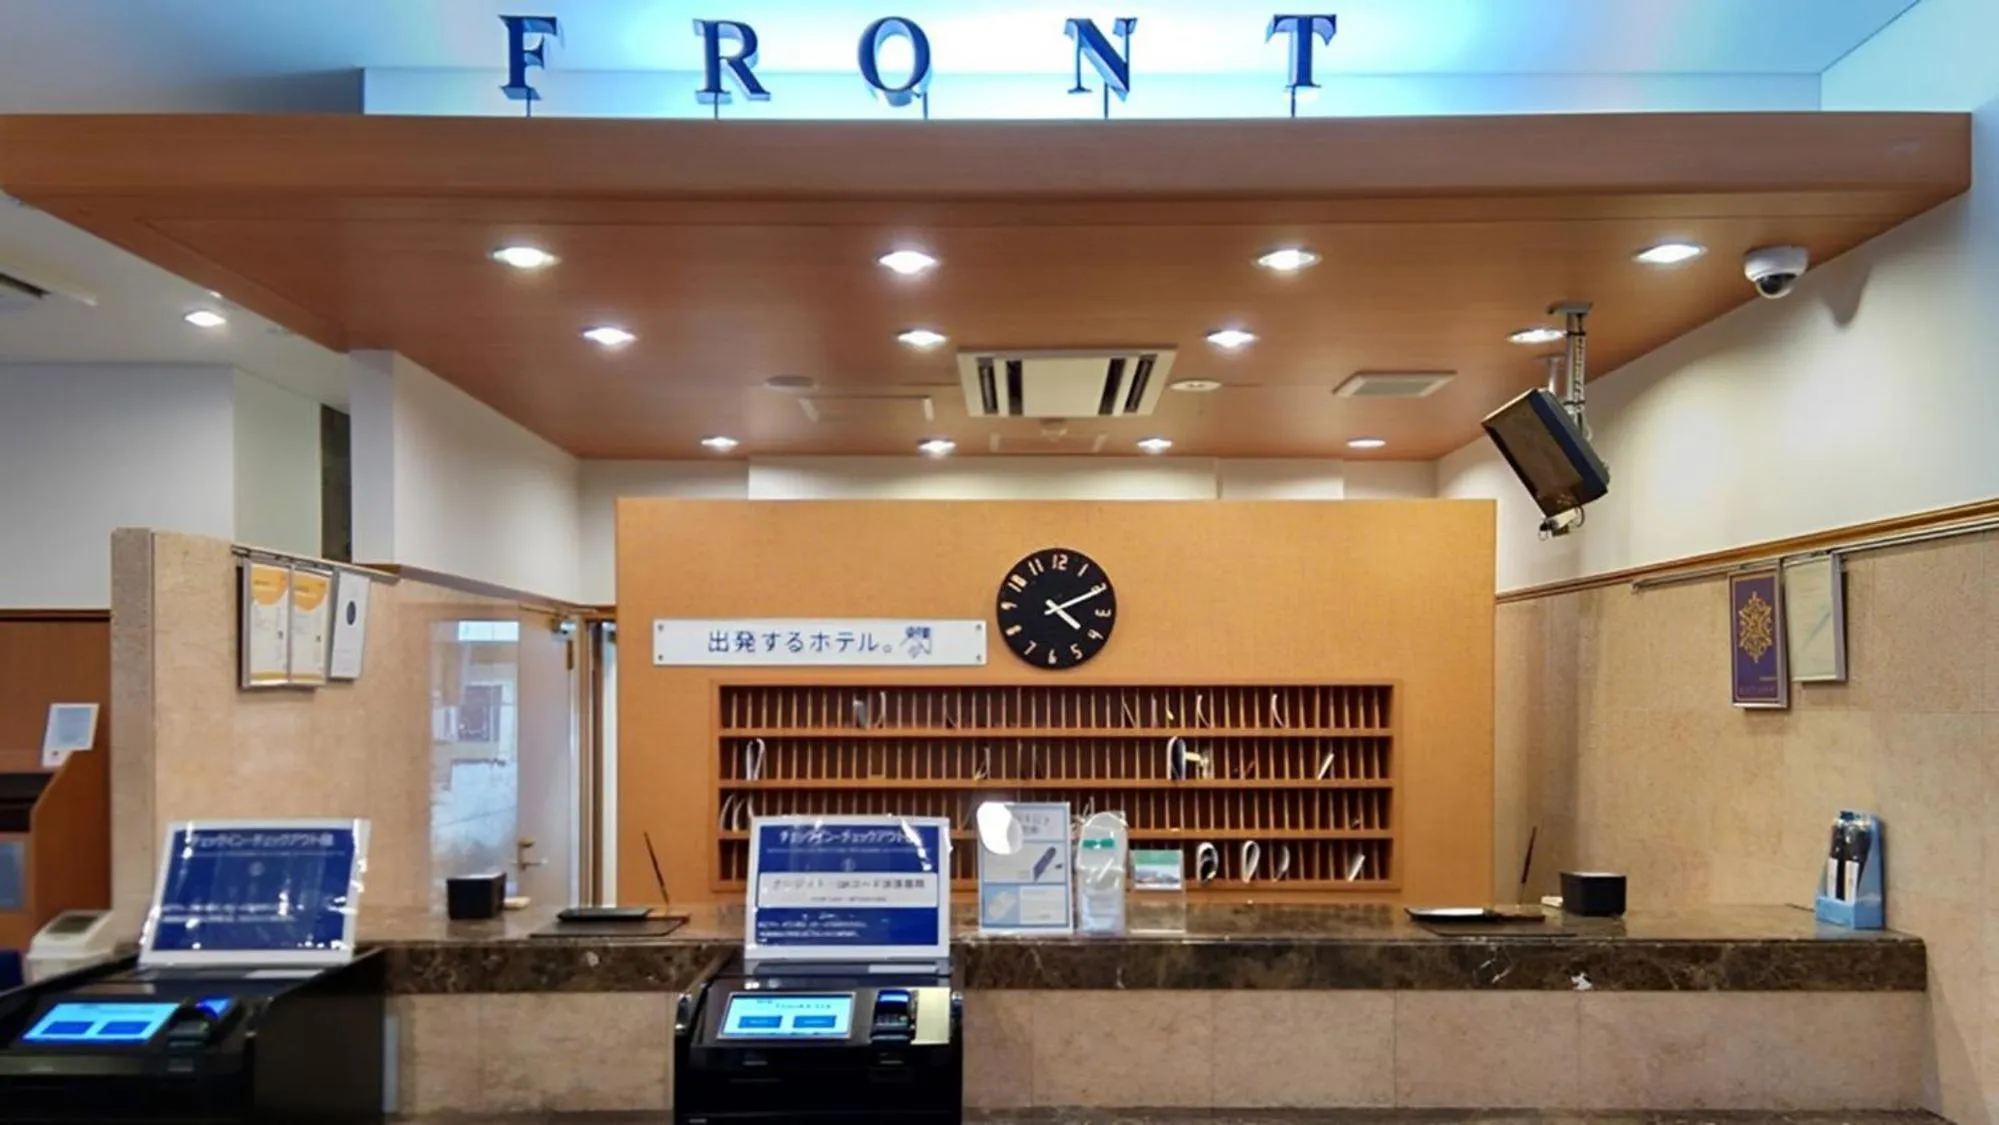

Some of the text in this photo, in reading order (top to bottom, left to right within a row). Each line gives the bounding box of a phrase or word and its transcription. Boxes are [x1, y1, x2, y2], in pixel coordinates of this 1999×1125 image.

[498, 14, 1337, 104] FRONT
[1027, 557, 1044, 575] 11
[1051, 553, 1068, 570] 12
[1077, 562, 1089, 576] 1
[1007, 573, 1027, 592] 10
[1000, 601, 1017, 610] 9
[1094, 608, 1111, 617] 3
[707, 629, 893, 654] 出発するホテル。
[1086, 628, 1103, 639] 4
[1023, 639, 1037, 655] 7
[1047, 647, 1057, 664] 6
[1069, 642, 1083, 660] 5
[779, 829, 917, 845] チェックイン・チェックアウト
